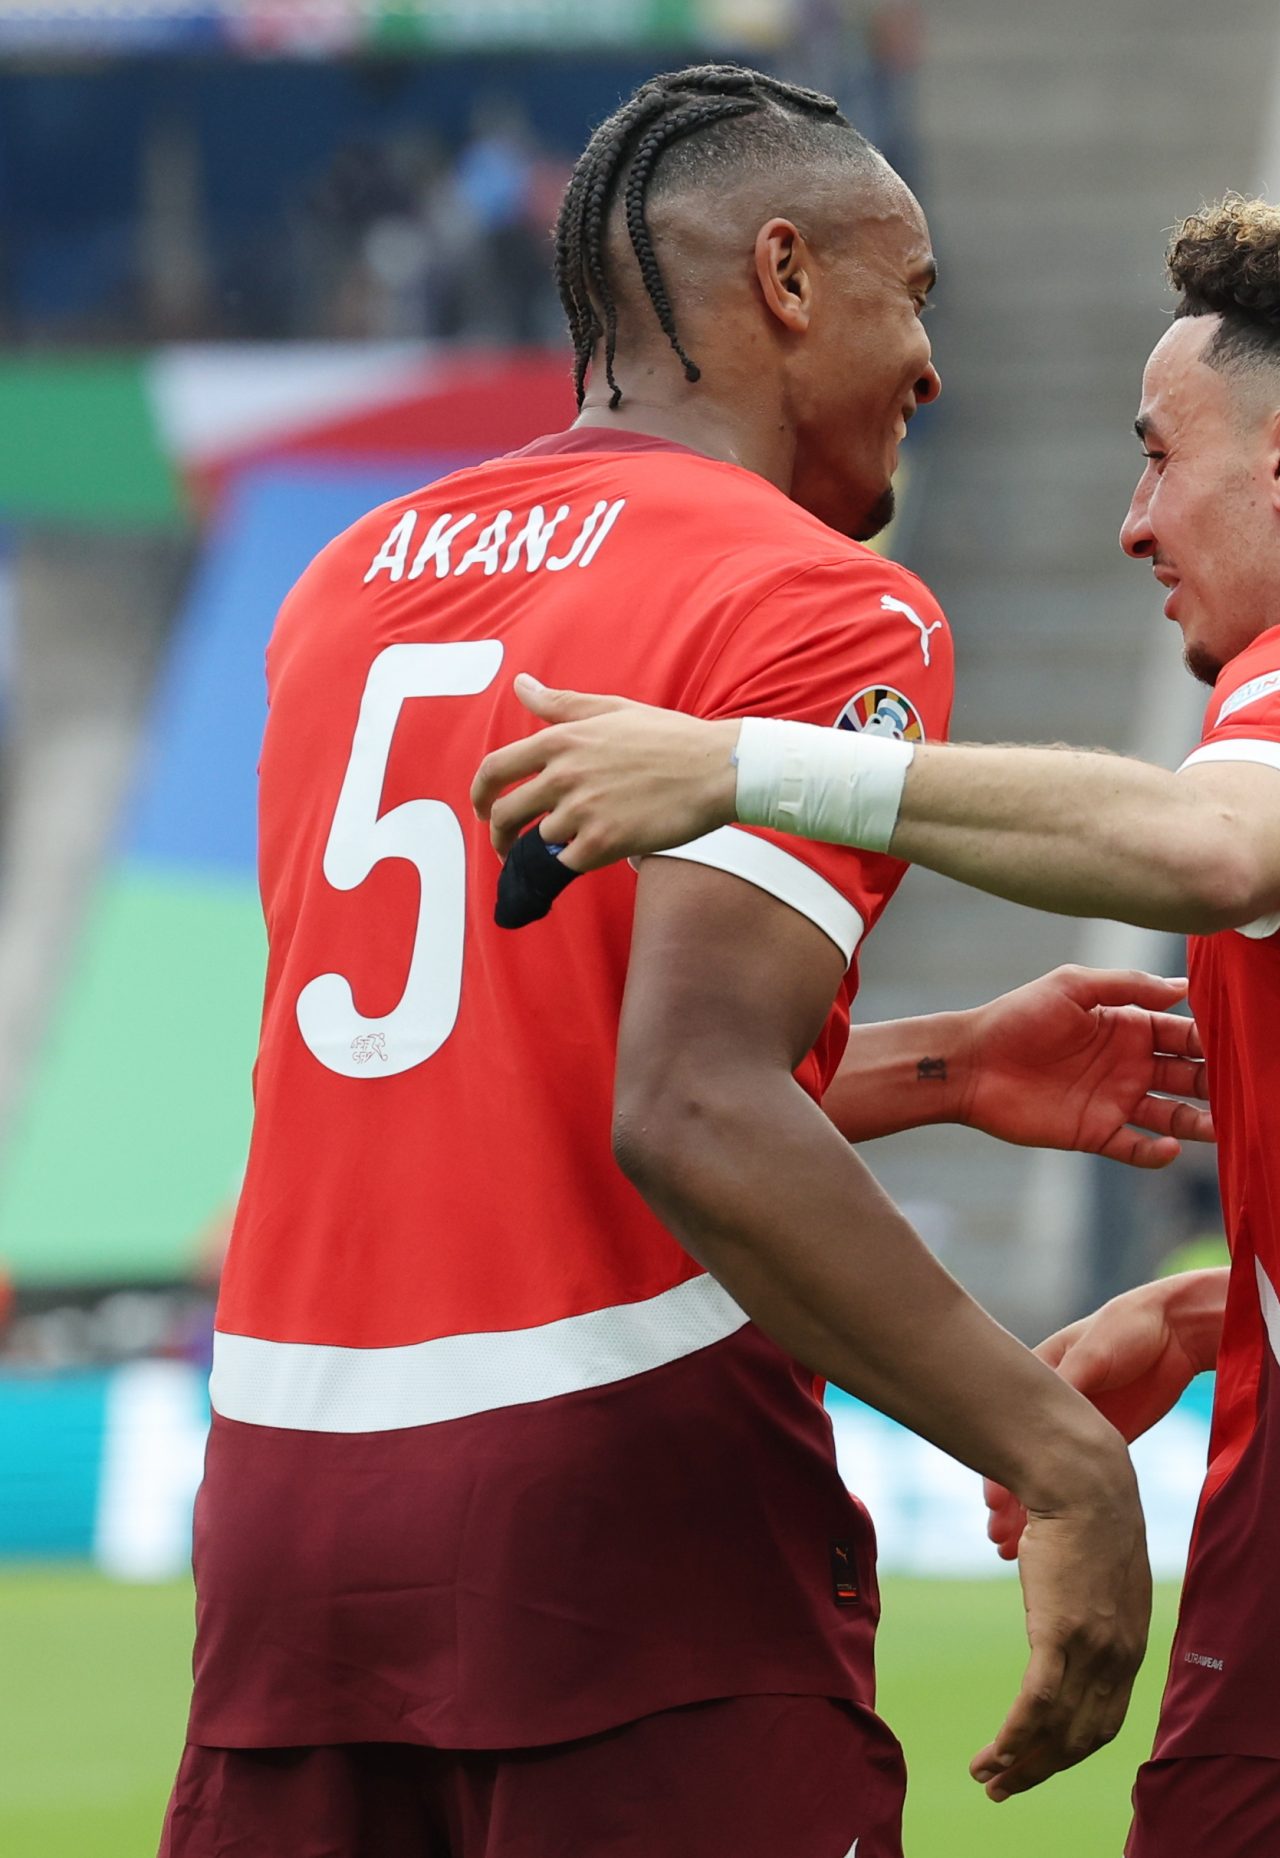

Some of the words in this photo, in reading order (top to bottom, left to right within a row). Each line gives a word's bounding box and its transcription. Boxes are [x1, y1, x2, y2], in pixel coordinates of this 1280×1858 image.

[363, 498, 626, 583] AKANJI
[296, 639, 504, 1079] 5
[1184, 1652, 1224, 1671] ULTRAWEAVE
